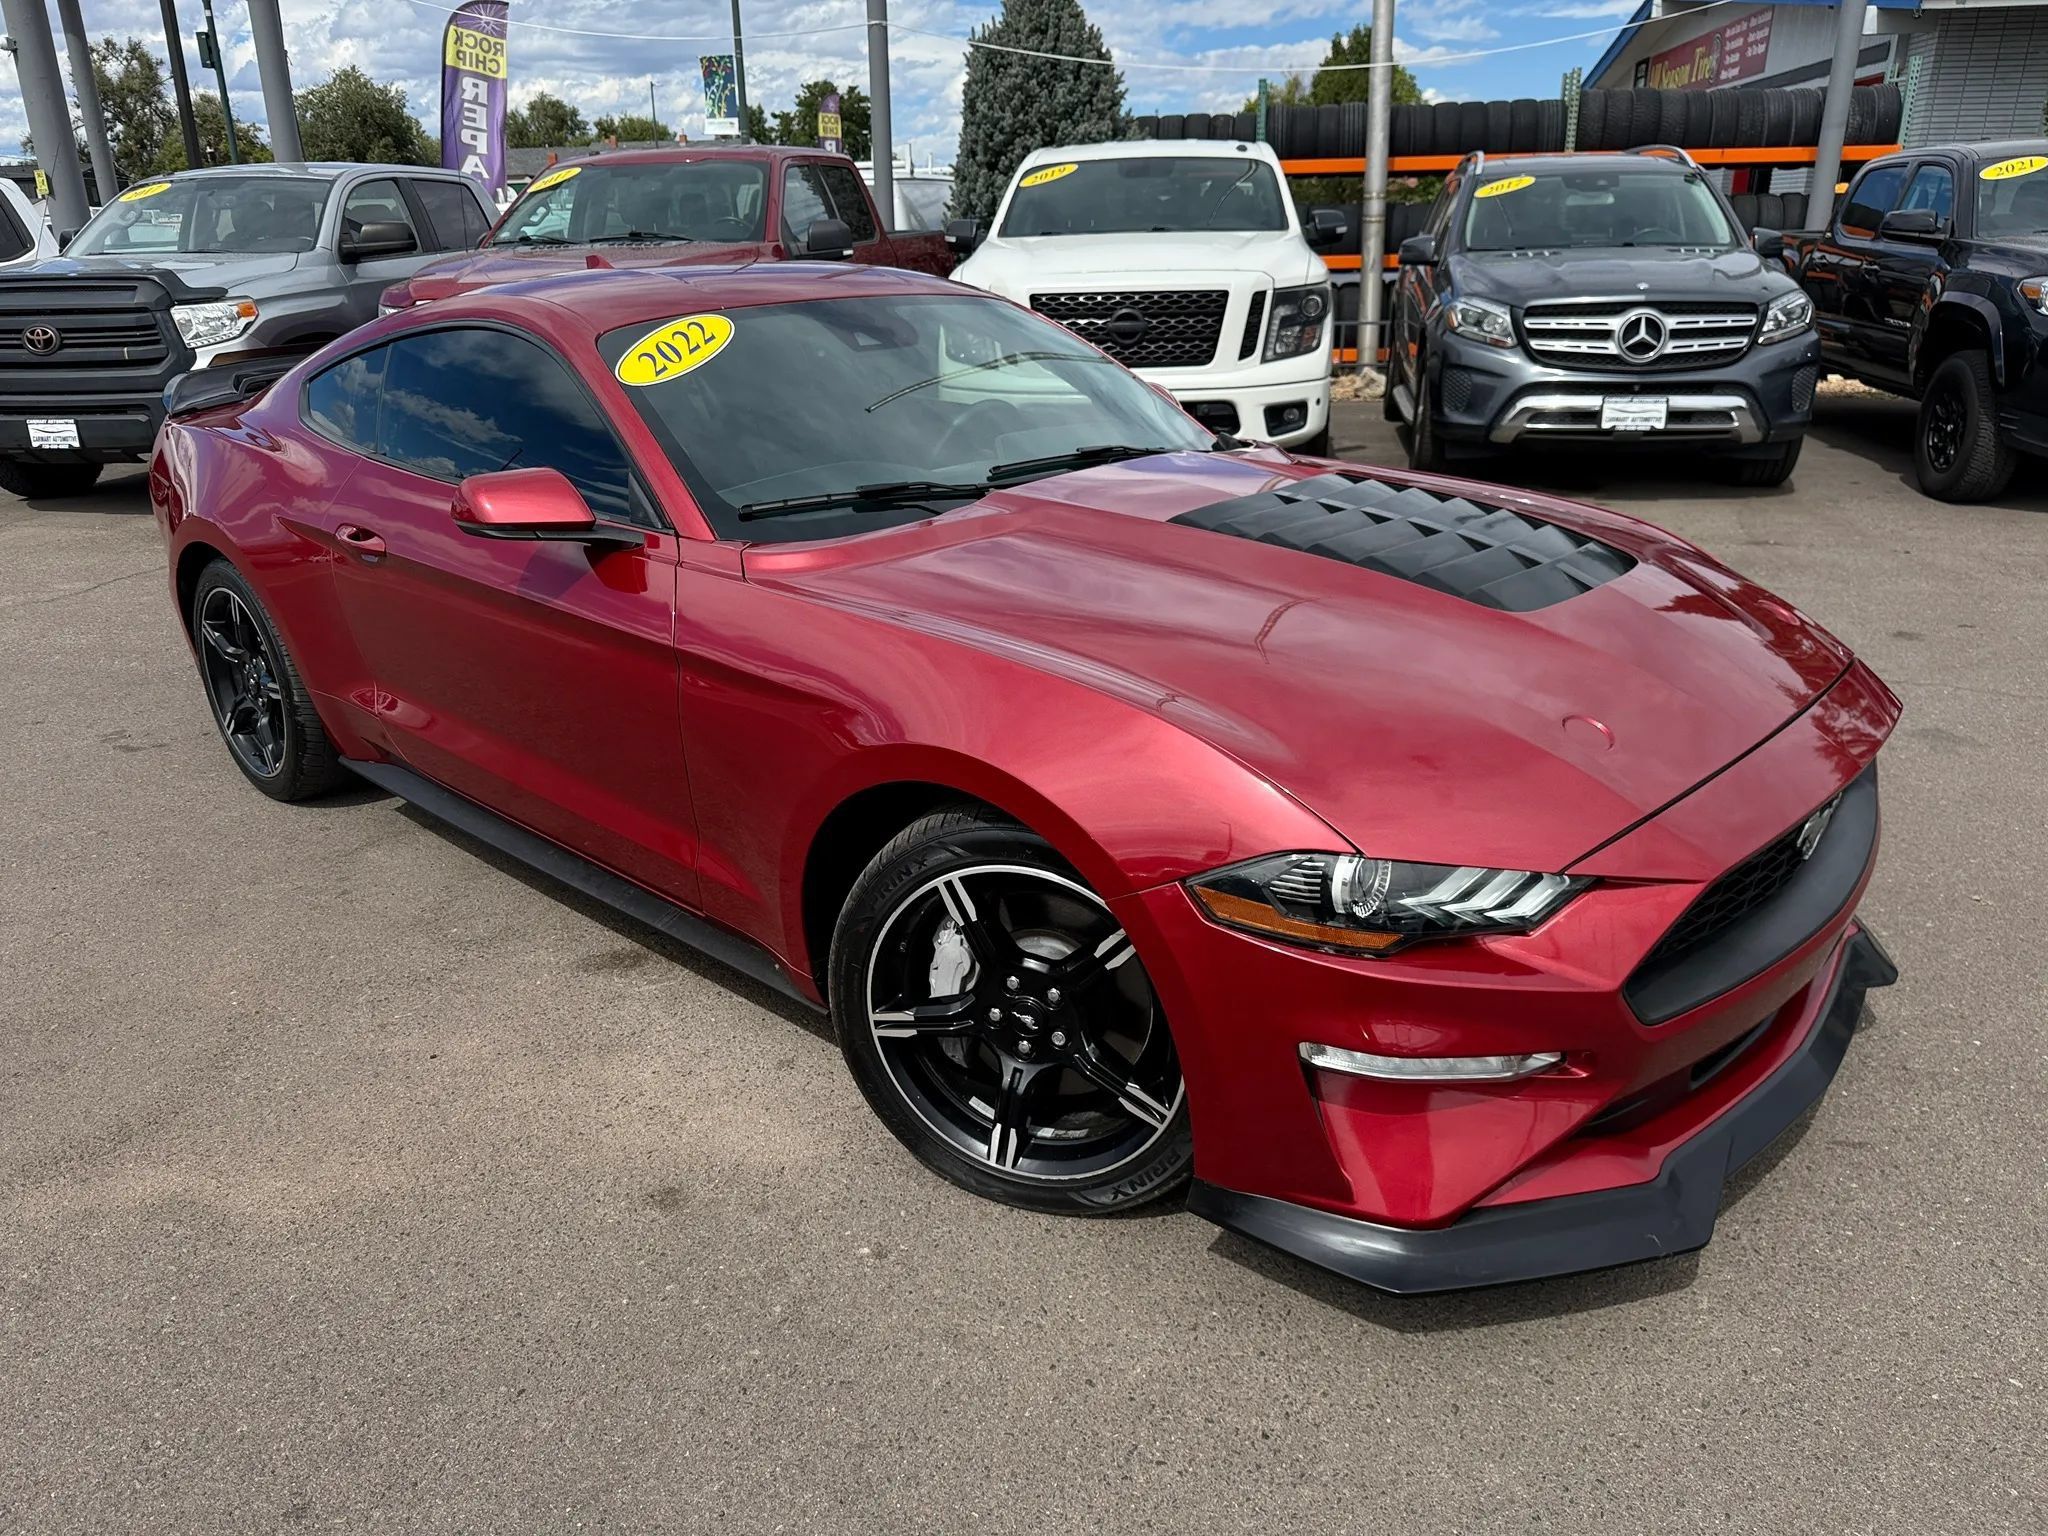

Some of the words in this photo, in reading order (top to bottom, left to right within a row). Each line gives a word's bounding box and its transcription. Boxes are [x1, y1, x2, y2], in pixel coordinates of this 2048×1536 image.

[1030, 166, 1067, 184] 2019
[1996, 159, 2033, 177] 2021
[637, 321, 717, 378] 2022
[1111, 1147, 1181, 1201] PRINX
